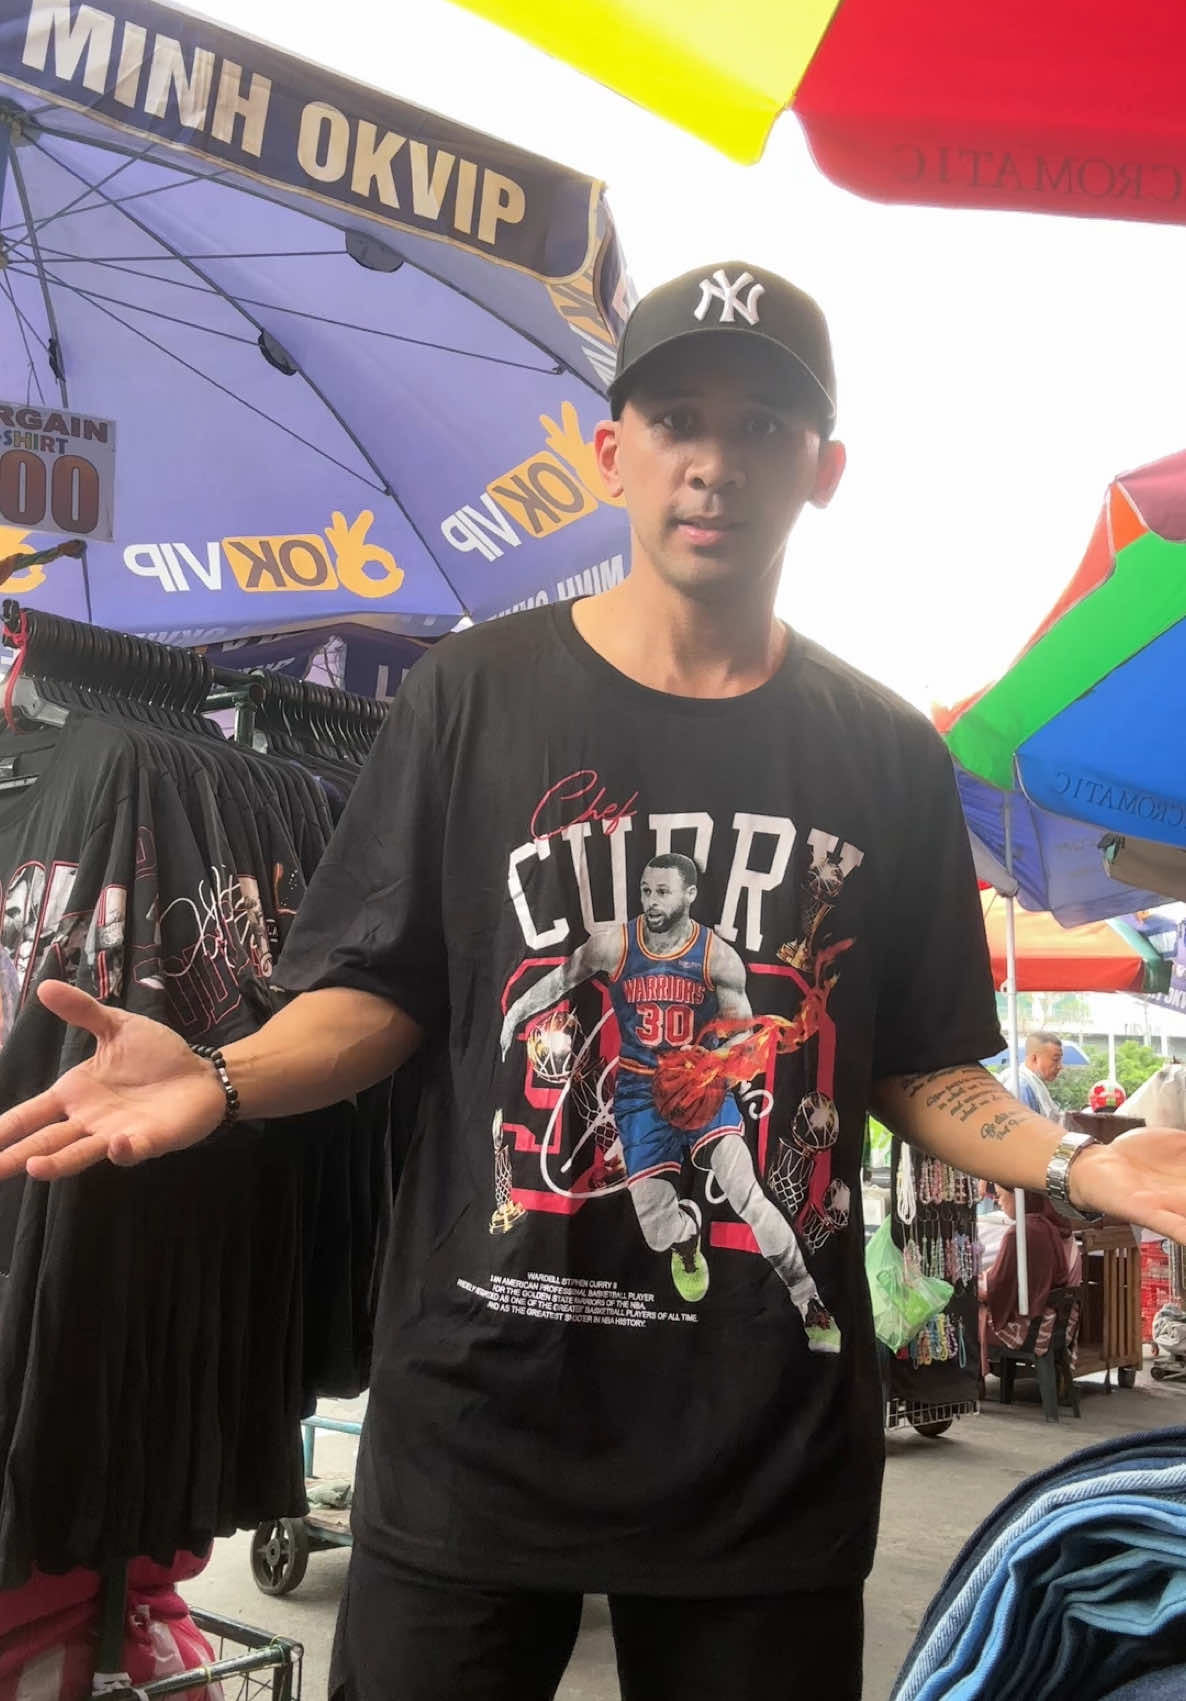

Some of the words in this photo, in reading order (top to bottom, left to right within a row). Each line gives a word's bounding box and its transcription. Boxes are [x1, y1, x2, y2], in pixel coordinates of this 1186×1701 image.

[21, 0, 272, 157] MINH
[297, 101, 526, 246] OKVIP
[694, 269, 766, 326] NY
[530, 769, 640, 842] Chef
[623, 974, 706, 1007] WARRIORS
[634, 1002, 696, 1048] 30
[502, 1278, 539, 1290] AMERICAN
[628, 1293, 655, 1302] PLAYER
[506, 1287, 521, 1296] THE
[522, 1289, 552, 1301] GOLDEN
[552, 1294, 574, 1304] STATE
[605, 1299, 615, 1307] OF
[616, 1300, 629, 1309] THE
[589, 1280, 612, 1289] CURRY
[499, 1293, 510, 1303] AS
[511, 1296, 526, 1305] ONE
[527, 1298, 538, 1307] OF
[538, 1300, 552, 1310] THE
[626, 1309, 657, 1319] PLAYERS
[657, 1312, 667, 1320] OF
[667, 1313, 680, 1321] ALL
[500, 1303, 510, 1312] AS
[511, 1305, 526, 1315] THE
[526, 1307, 564, 1320] GREATEST
